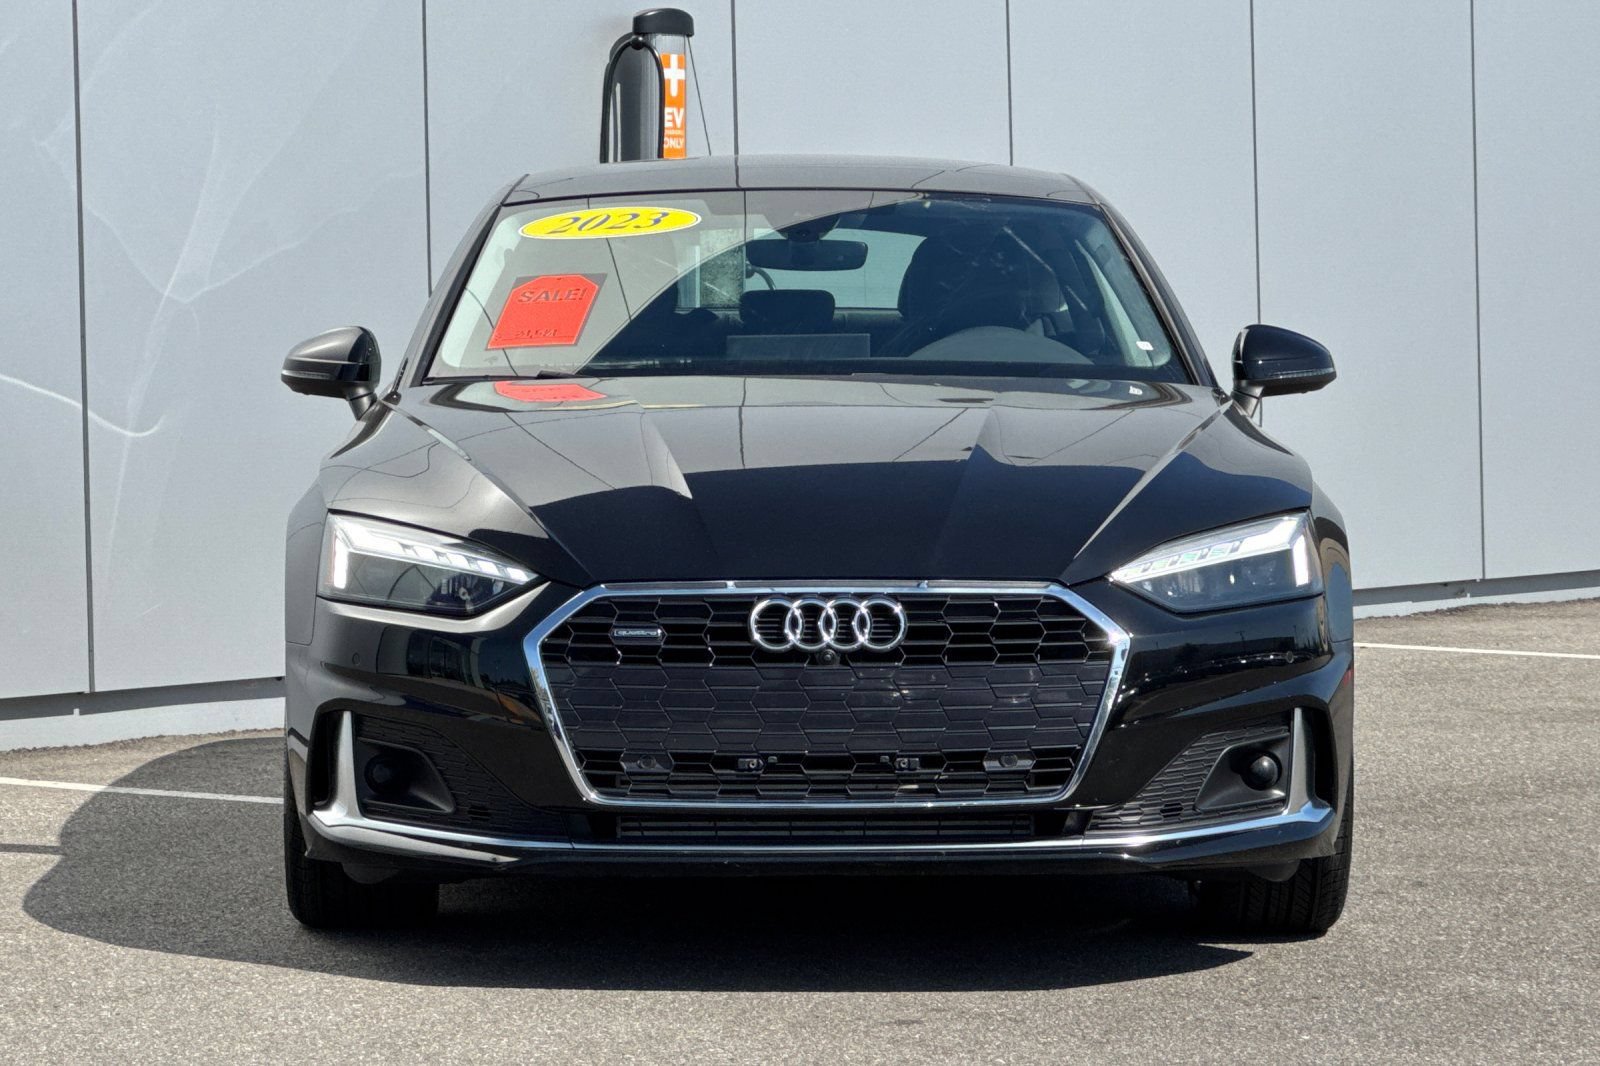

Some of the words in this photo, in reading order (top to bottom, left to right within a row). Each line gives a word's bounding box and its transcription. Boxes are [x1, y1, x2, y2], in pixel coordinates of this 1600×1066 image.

[664, 107, 684, 128] EV
[664, 137, 684, 149] ONLY
[545, 212, 670, 235] 2023
[518, 287, 588, 303] SALE!
